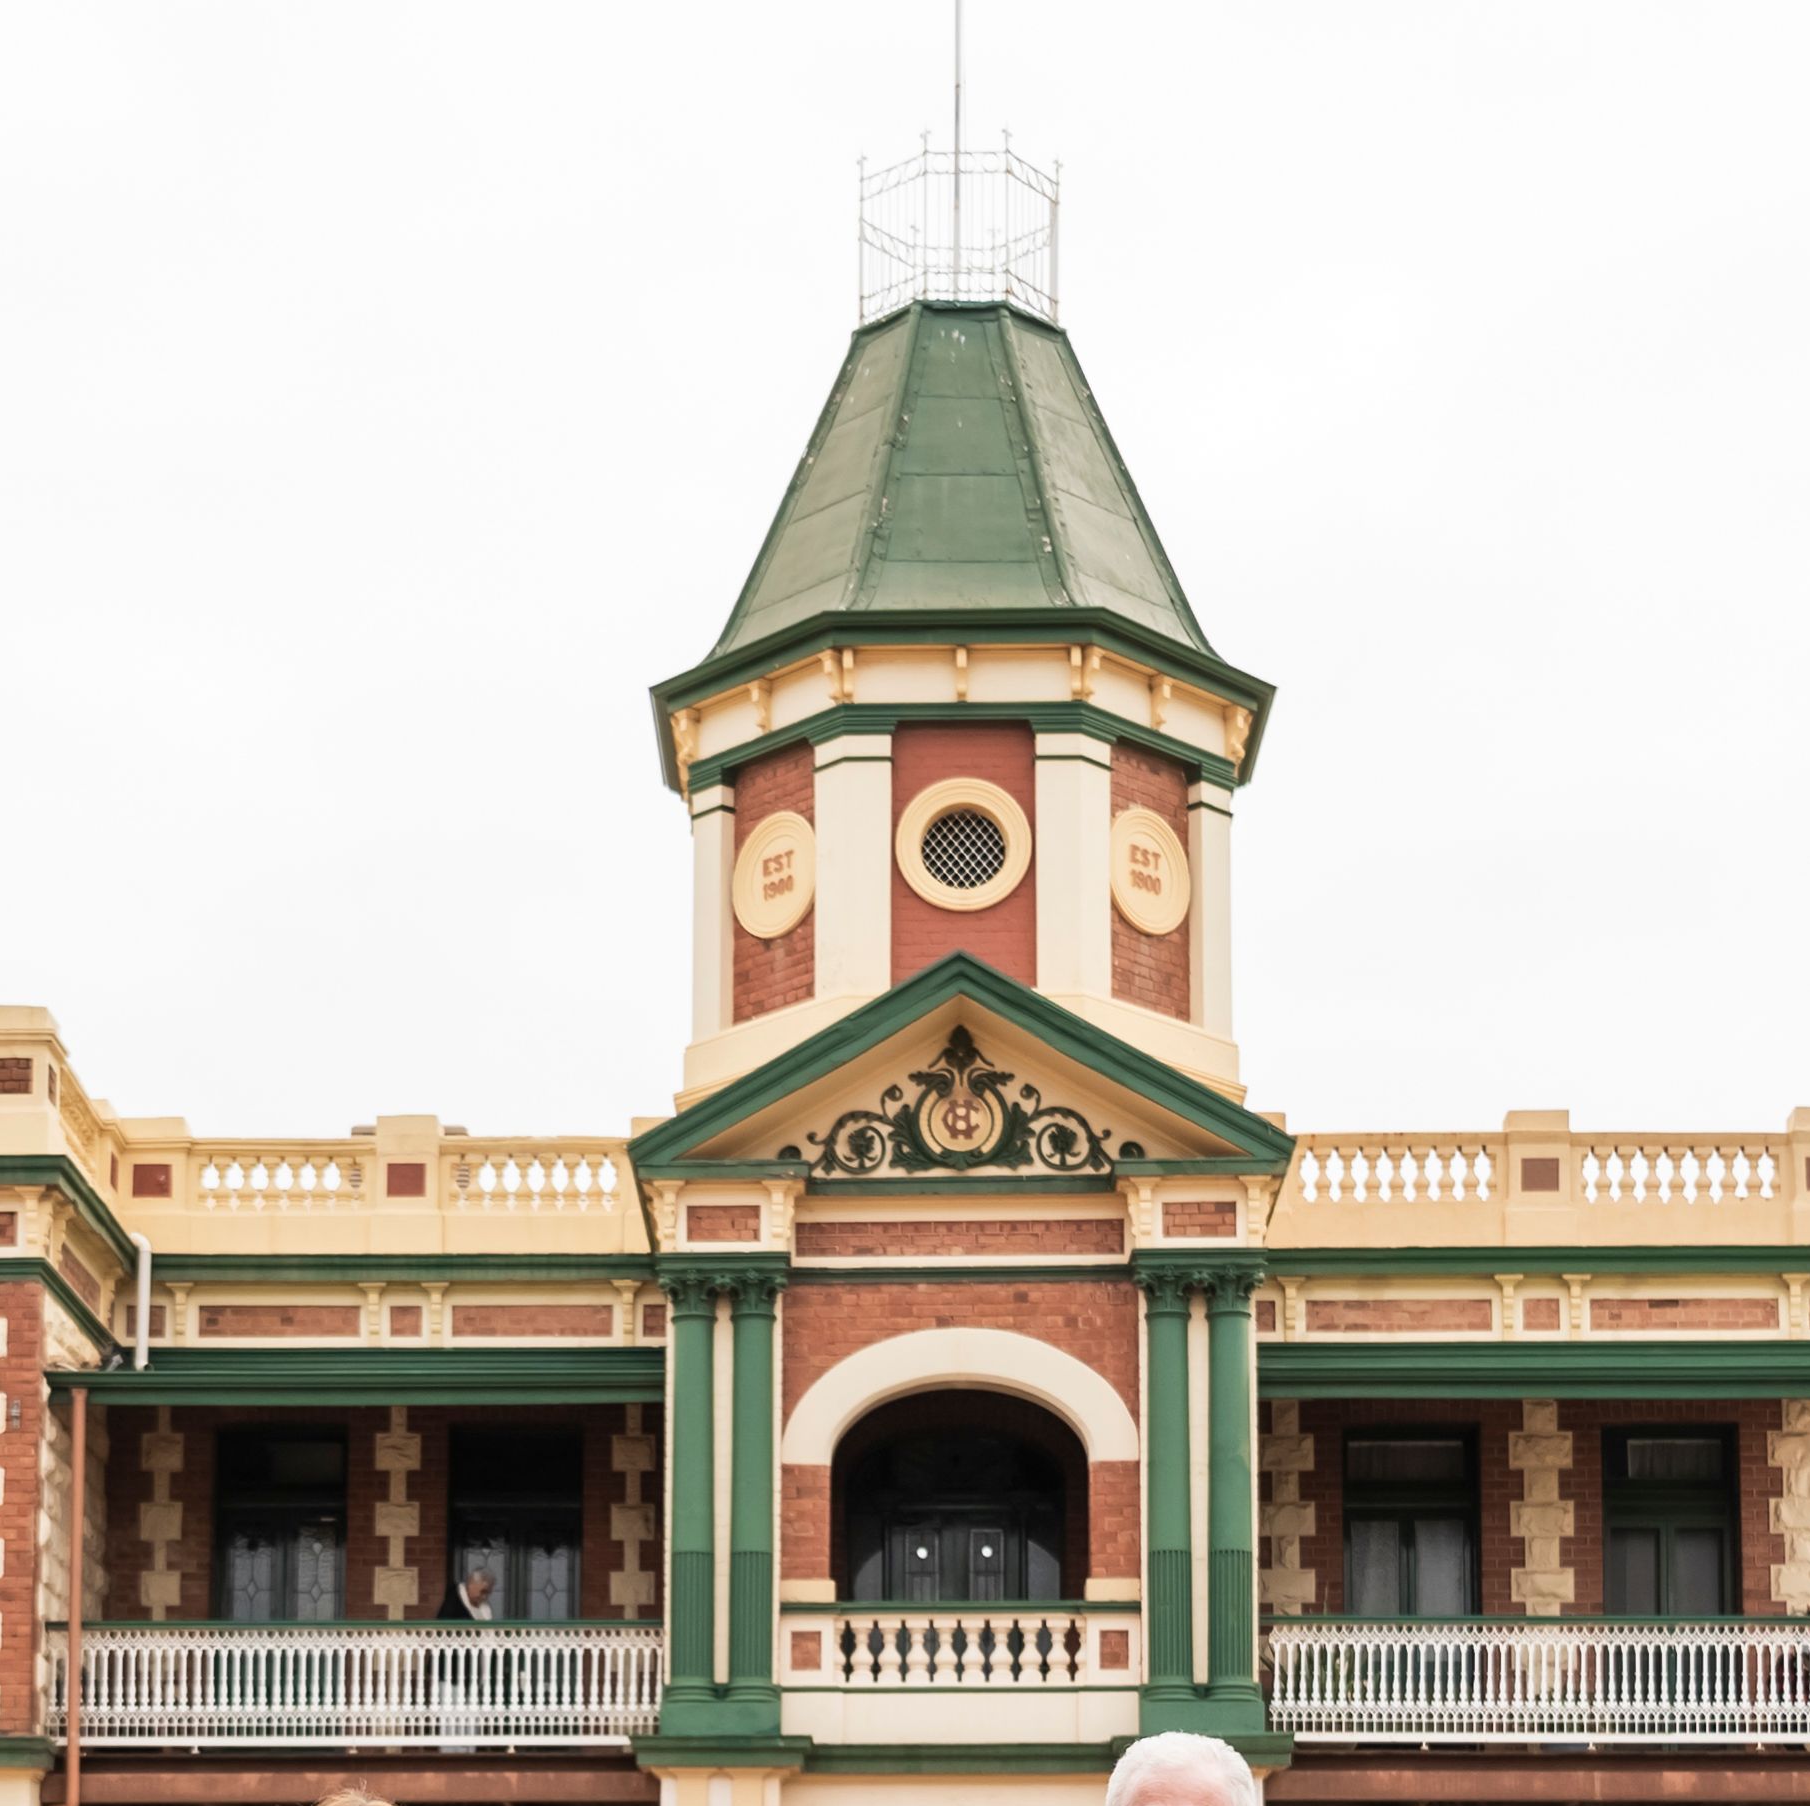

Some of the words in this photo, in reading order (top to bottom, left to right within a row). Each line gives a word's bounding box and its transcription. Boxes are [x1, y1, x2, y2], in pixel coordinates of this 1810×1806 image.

[762, 849, 794, 877] EST
[1130, 844, 1161, 870] EST
[1130, 868, 1161, 896] 1900
